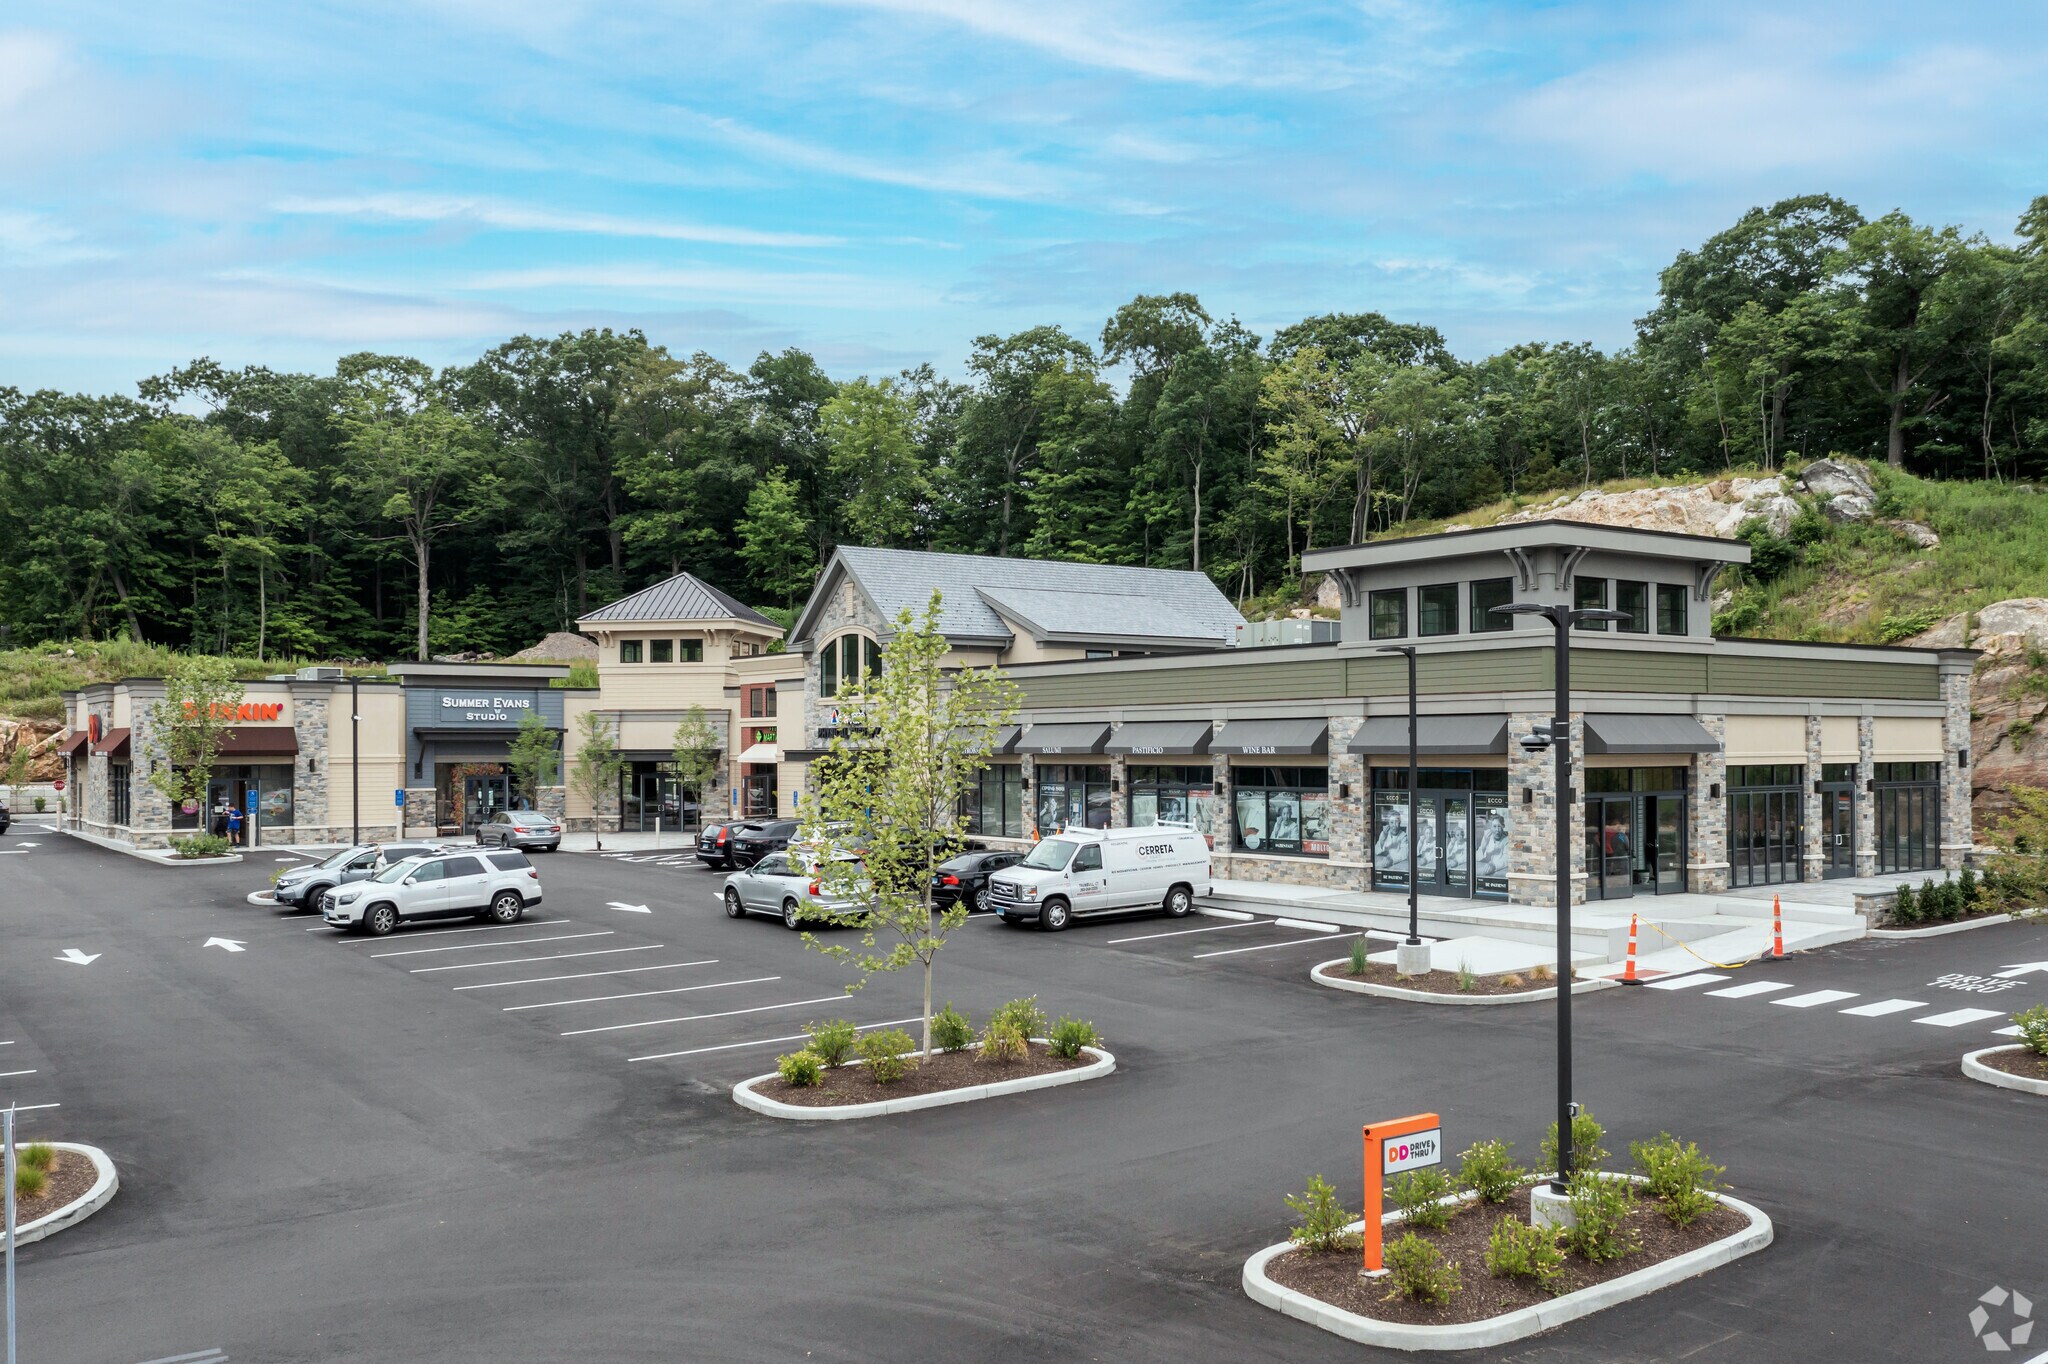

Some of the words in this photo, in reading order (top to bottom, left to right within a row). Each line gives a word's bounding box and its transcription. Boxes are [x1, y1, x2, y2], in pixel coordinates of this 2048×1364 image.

[442, 697, 489, 707] SUMMER
[493, 697, 530, 708] EVANS
[466, 712, 507, 720] STUDIO
[763, 733, 777, 741] MART
[1242, 746, 1260, 754] WINE
[1261, 746, 1276, 754] BAR
[1138, 844, 1174, 856] CERRETA
[1926, 979, 2006, 993] THRU
[1937, 973, 2028, 988] DRIVE
[1388, 1145, 1409, 1163] DD
[1410, 1140, 1430, 1151] DRIVE
[1410, 1149, 1429, 1159] THRU
